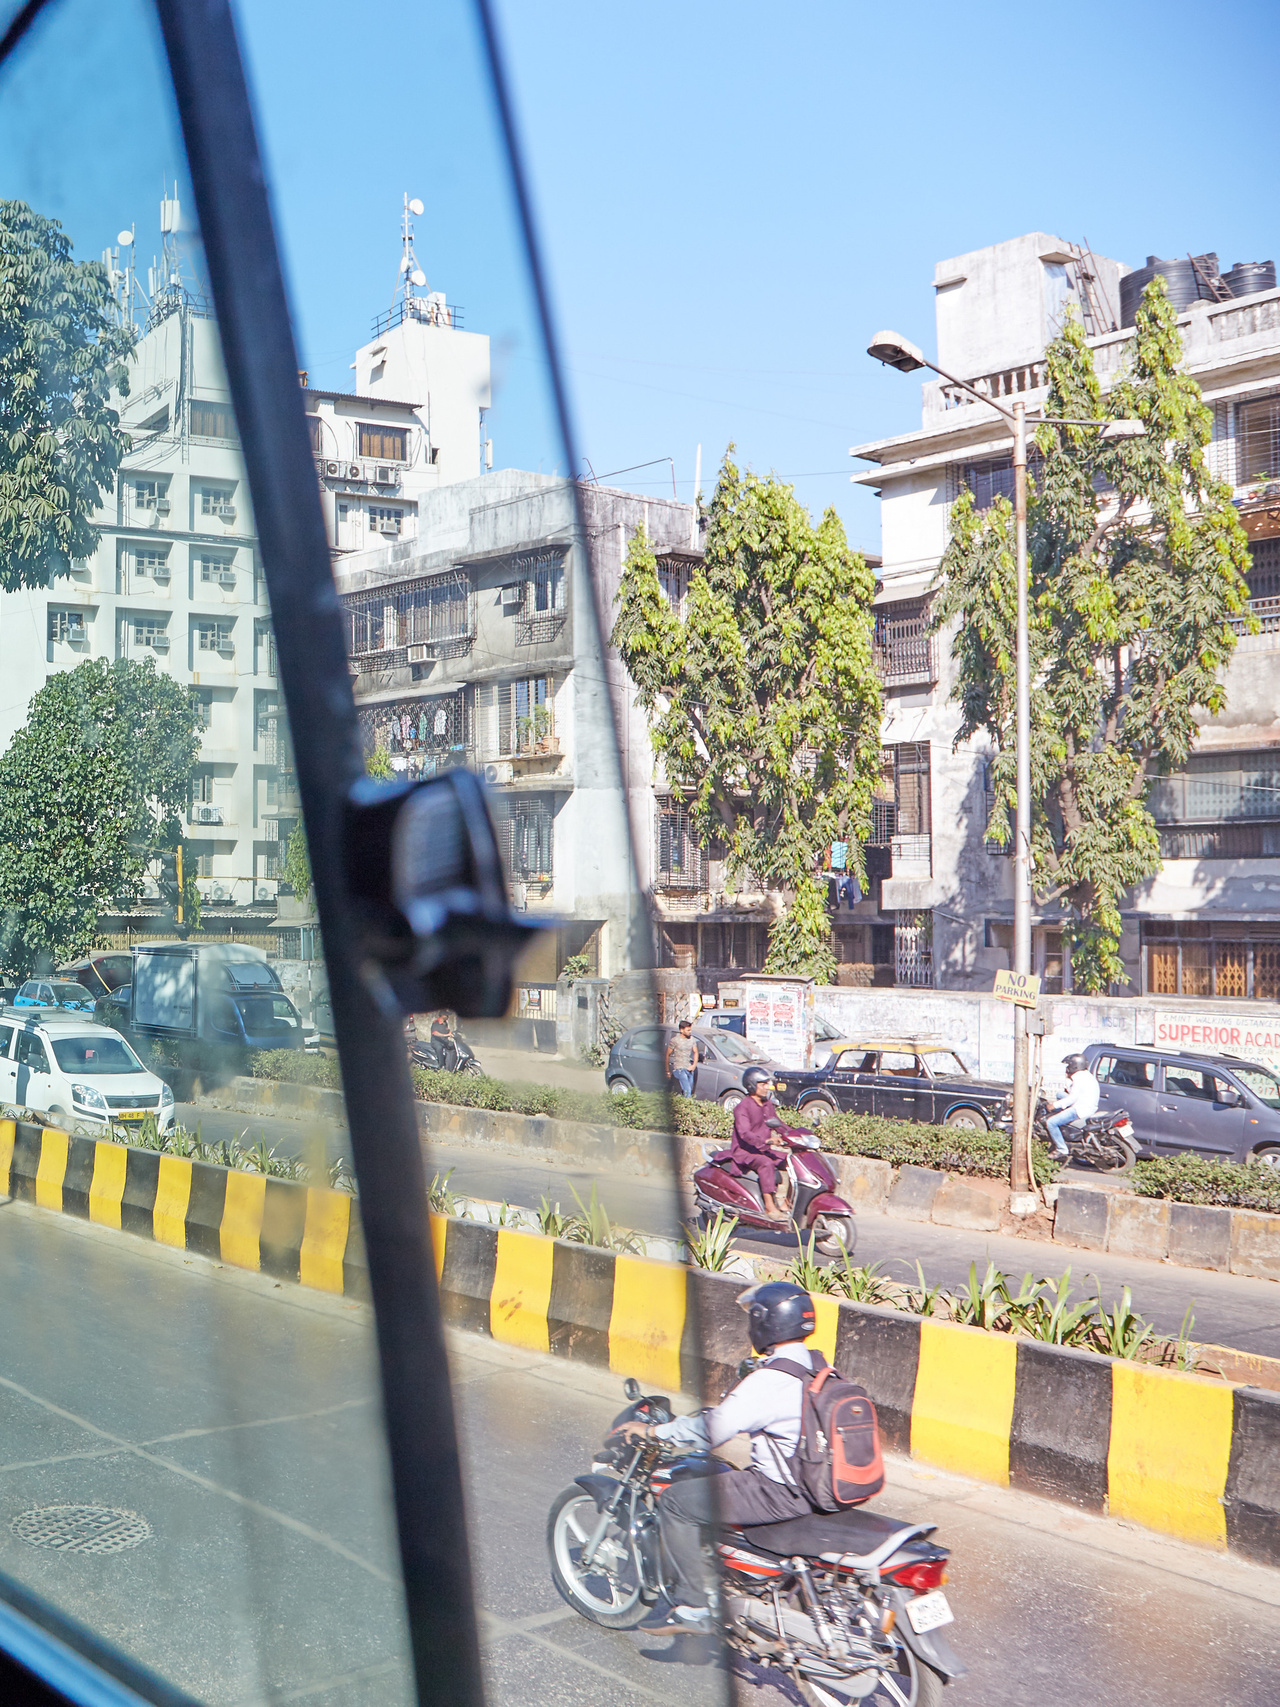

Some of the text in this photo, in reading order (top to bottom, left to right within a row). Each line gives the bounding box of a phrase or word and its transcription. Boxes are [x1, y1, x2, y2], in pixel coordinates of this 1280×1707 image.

[1008, 973, 1027, 988] NO
[995, 984, 1036, 1000] PARKING
[1196, 1016, 1232, 1025] WALKING
[1236, 1019, 1273, 1028] DISTANCE
[1158, 1024, 1241, 1045] SUPERIOR
[1223, 1046, 1253, 1054] STARTED
